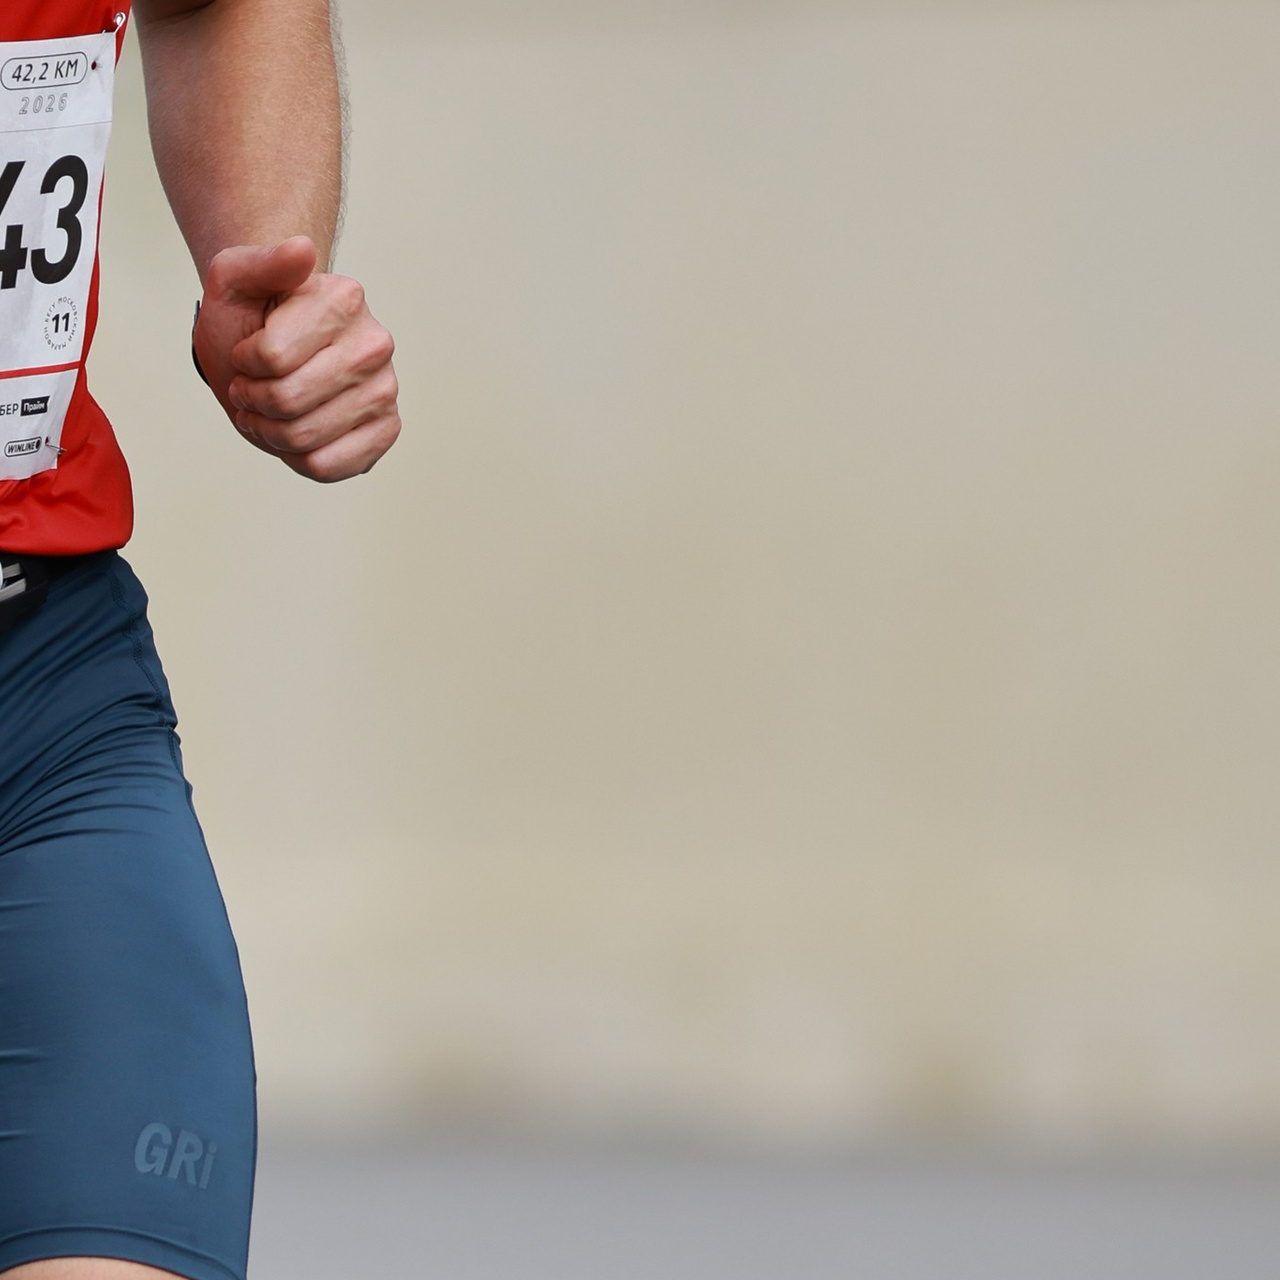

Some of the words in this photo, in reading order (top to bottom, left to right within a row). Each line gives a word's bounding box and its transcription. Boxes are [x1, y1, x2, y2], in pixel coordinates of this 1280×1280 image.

[11, 62, 49, 84] 42,2
[19, 93, 69, 115] 2026
[51, 312, 70, 334] 11
